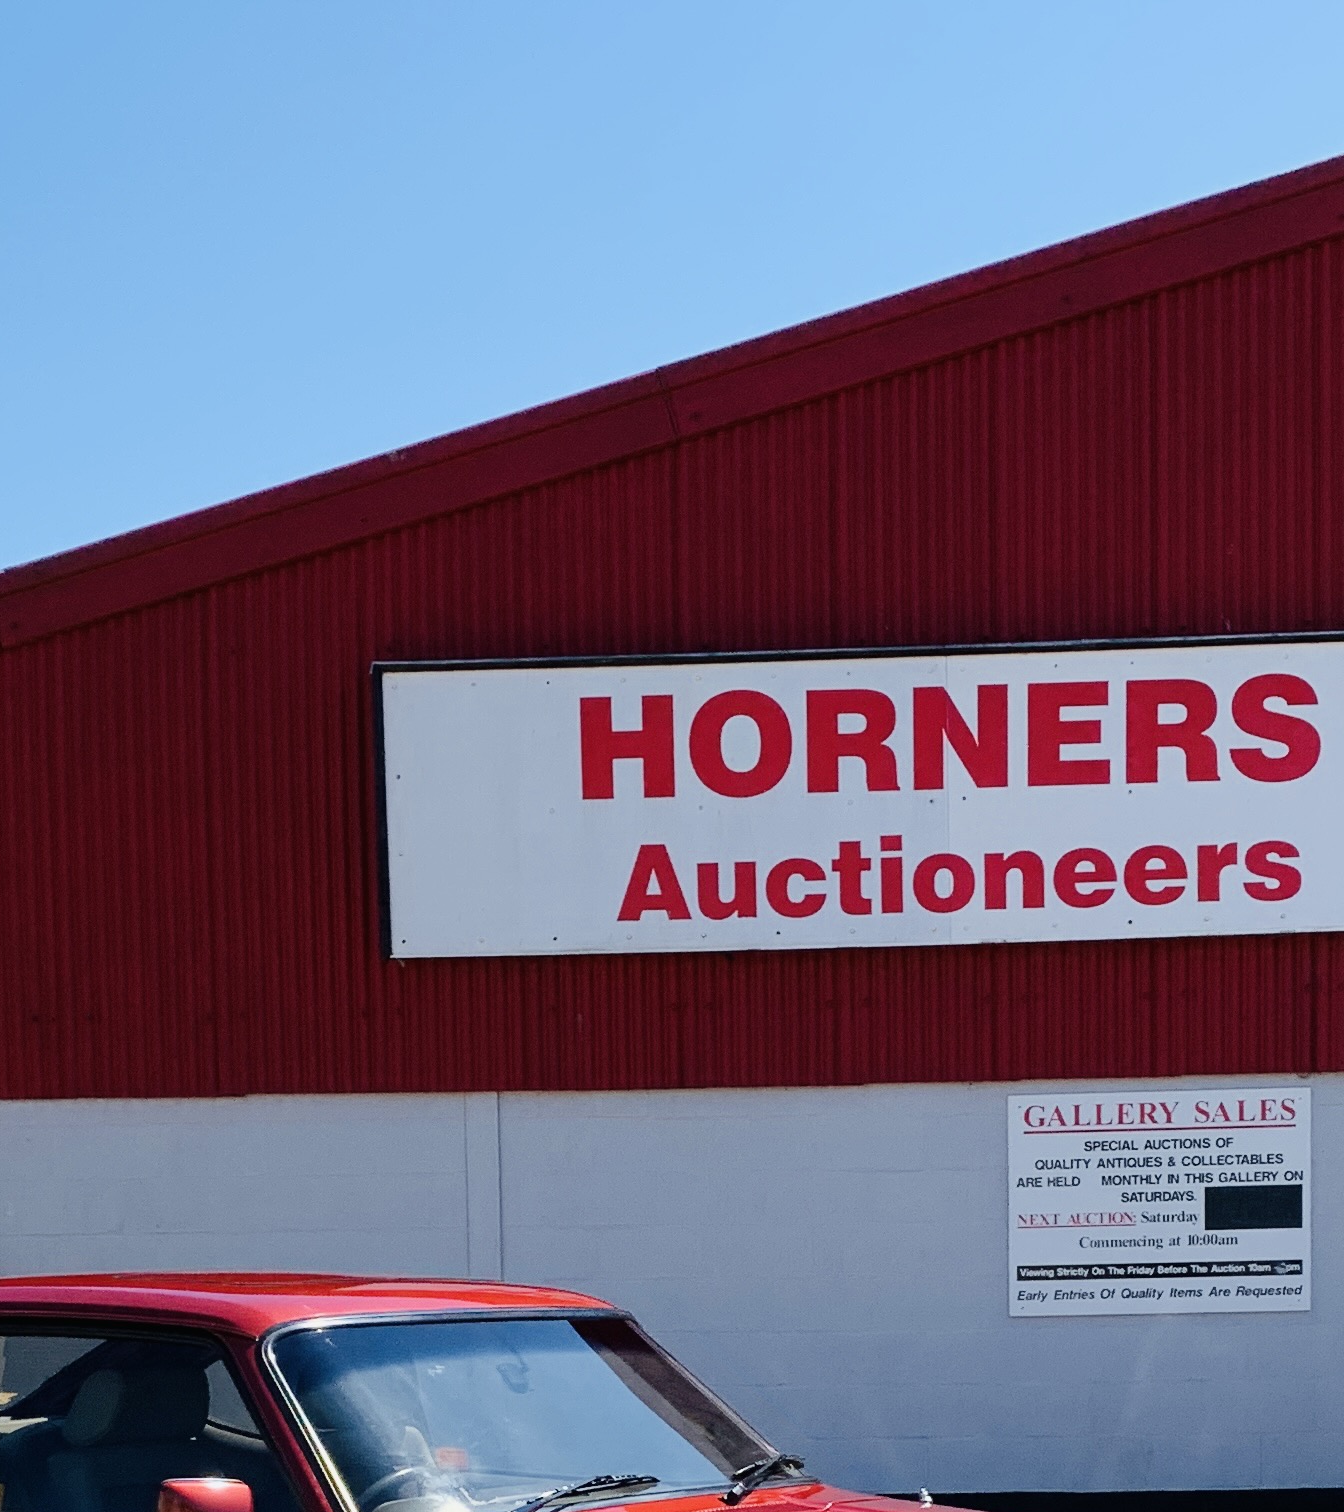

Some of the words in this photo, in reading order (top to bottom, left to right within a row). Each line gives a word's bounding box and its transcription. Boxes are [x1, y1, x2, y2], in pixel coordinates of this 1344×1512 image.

[579, 673, 1321, 800] HORNERS
[616, 835, 1302, 922] Auctioneers
[1023, 1101, 1179, 1128] GALLERY
[1194, 1098, 1296, 1123] SALES
[1083, 1140, 1138, 1152] SPECIAL
[1144, 1137, 1211, 1150] AUCTIONS
[1216, 1137, 1234, 1148] OF
[1035, 1158, 1092, 1171] QUALITY
[1096, 1156, 1163, 1169] ANTIQUES
[1167, 1156, 1176, 1167] &
[1181, 1154, 1284, 1167] COLLECTABLES
[1016, 1176, 1043, 1188] ARE
[1047, 1175, 1081, 1187] HELD
[1101, 1173, 1162, 1186] MONTHLY
[1167, 1174, 1180, 1184] IN
[1184, 1173, 1214, 1184] THIS
[1218, 1171, 1278, 1183] GALLERY
[1284, 1170, 1304, 1181] ON
[1017, 1213, 1060, 1226] NEXT
[1140, 1210, 1199, 1226] Saturday
[1079, 1235, 1164, 1250] Commencing
[1168, 1236, 1181, 1247] at
[1188, 1233, 1239, 1246] 10:00am
[1019, 1267, 1055, 1278] Viewing
[1056, 1266, 1089, 1278] Strictly
[1091, 1266, 1106, 1276] On
[1108, 1265, 1125, 1276] The
[1127, 1265, 1156, 1276] Friday
[1157, 1265, 1188, 1275] Before
[1190, 1264, 1208, 1274] The
[1211, 1263, 1246, 1273] Auction
[1017, 1289, 1048, 1303] Early
[1054, 1288, 1095, 1301] Entries
[1099, 1287, 1116, 1299] Of
[1121, 1287, 1164, 1300] Quality
[1169, 1287, 1203, 1298] Items
[1208, 1286, 1231, 1297] Are
[1236, 1284, 1303, 1299] Requested
